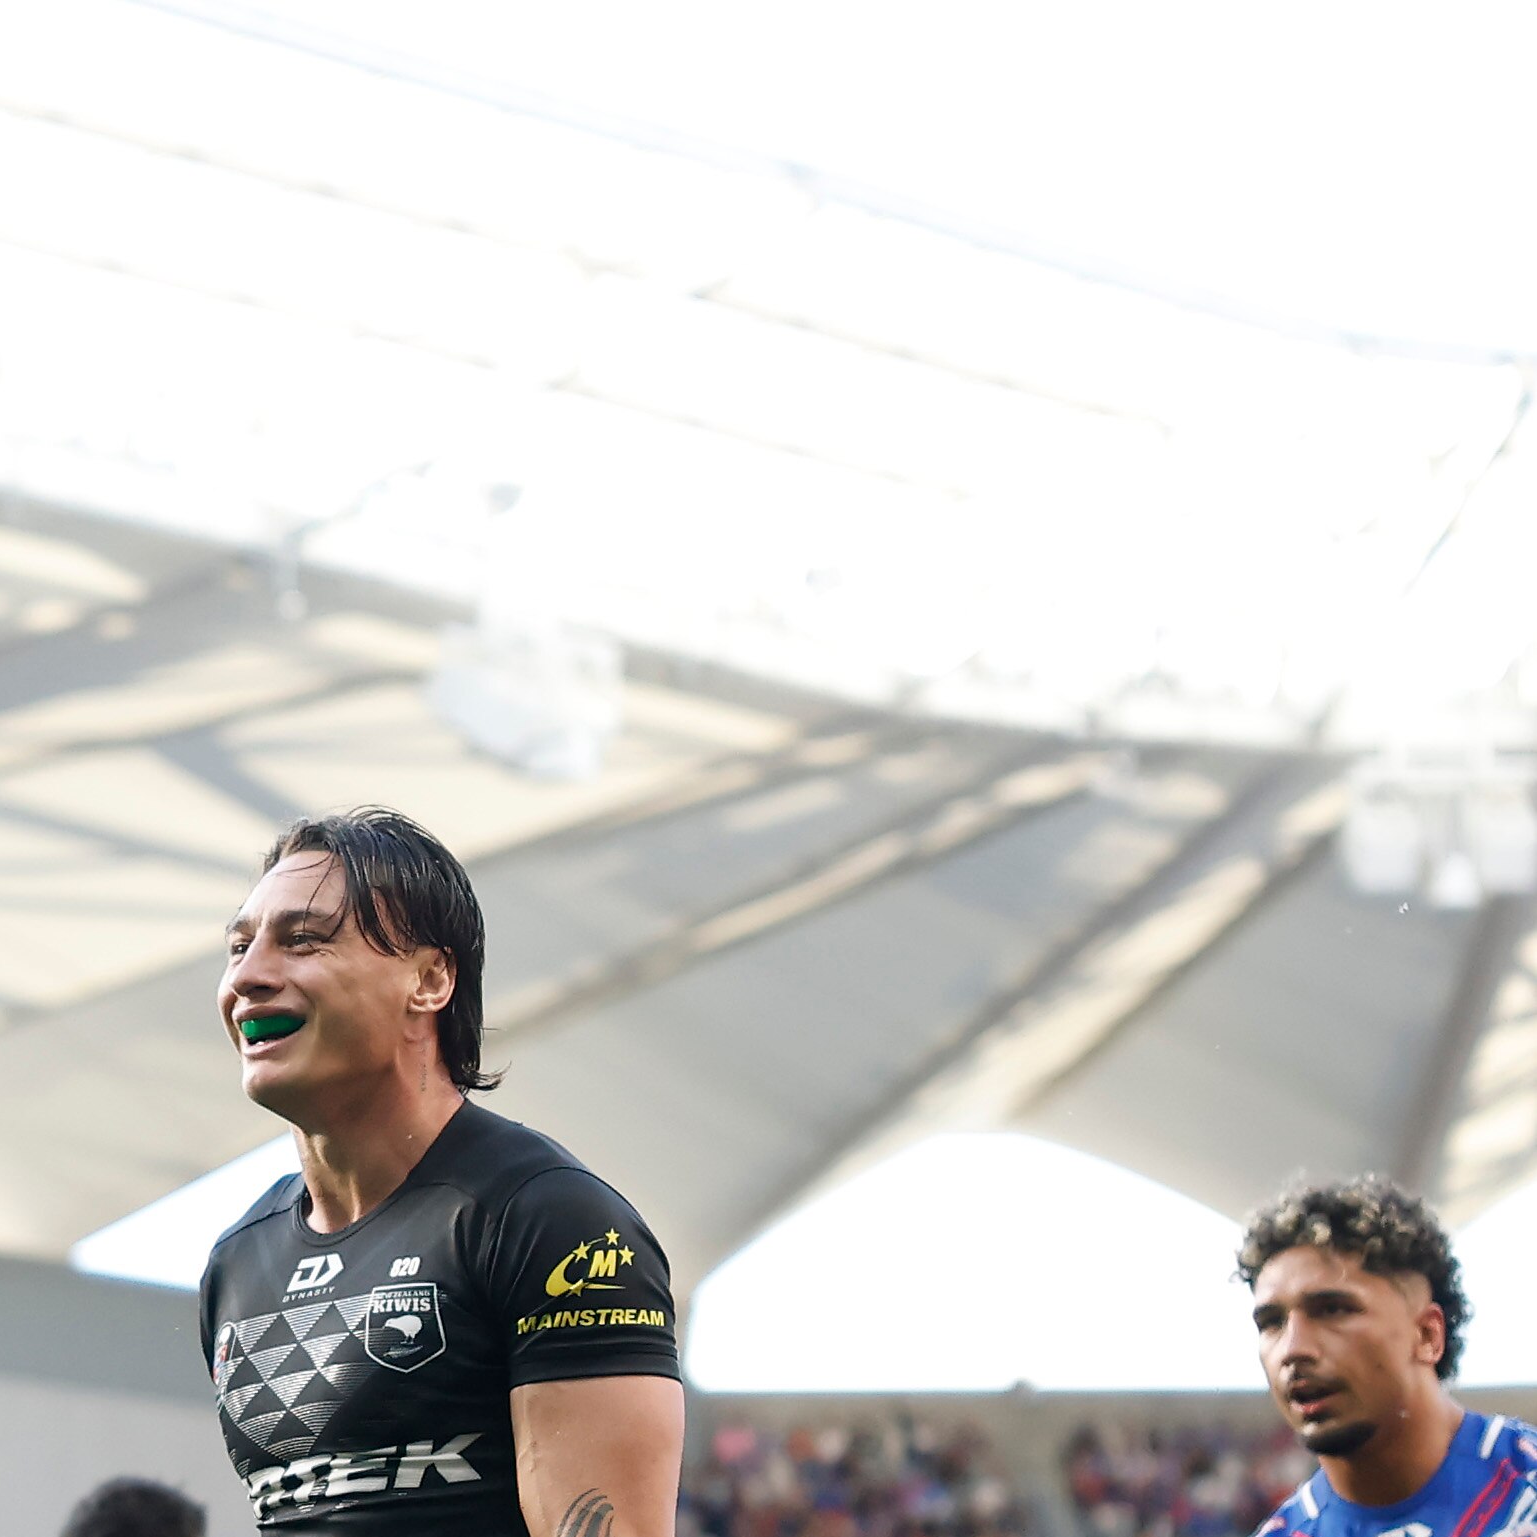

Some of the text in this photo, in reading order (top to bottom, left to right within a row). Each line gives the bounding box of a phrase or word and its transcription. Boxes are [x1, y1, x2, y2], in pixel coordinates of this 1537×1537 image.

[389, 1256, 422, 1278] 820
[282, 1286, 336, 1304] DYNASTY
[372, 1297, 432, 1314] KIWIS
[517, 1308, 666, 1335] MAINSTREAM
